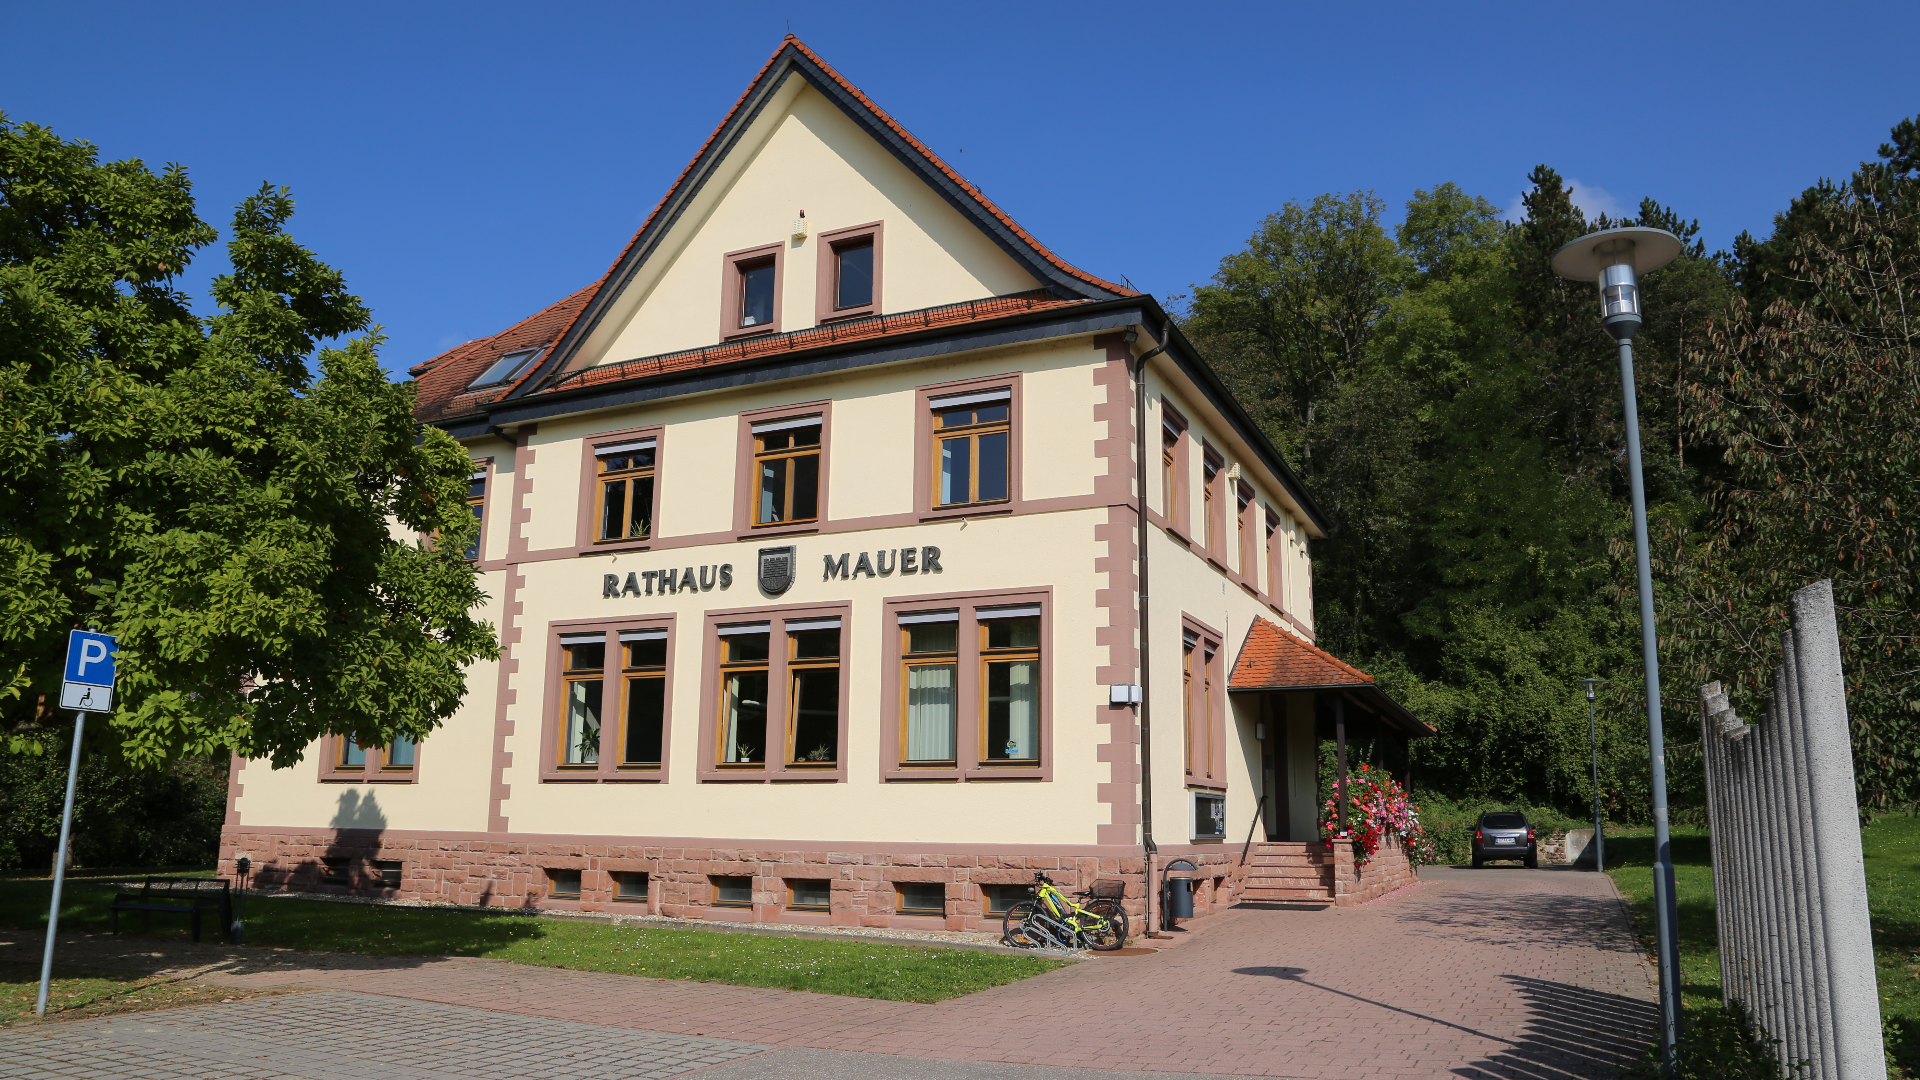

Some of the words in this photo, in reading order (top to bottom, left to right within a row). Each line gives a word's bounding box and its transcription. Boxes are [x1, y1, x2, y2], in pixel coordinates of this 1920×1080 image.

[603, 563, 733, 598] RATHAUS
[823, 545, 943, 580] MAUER
[78, 638, 107, 676] P
